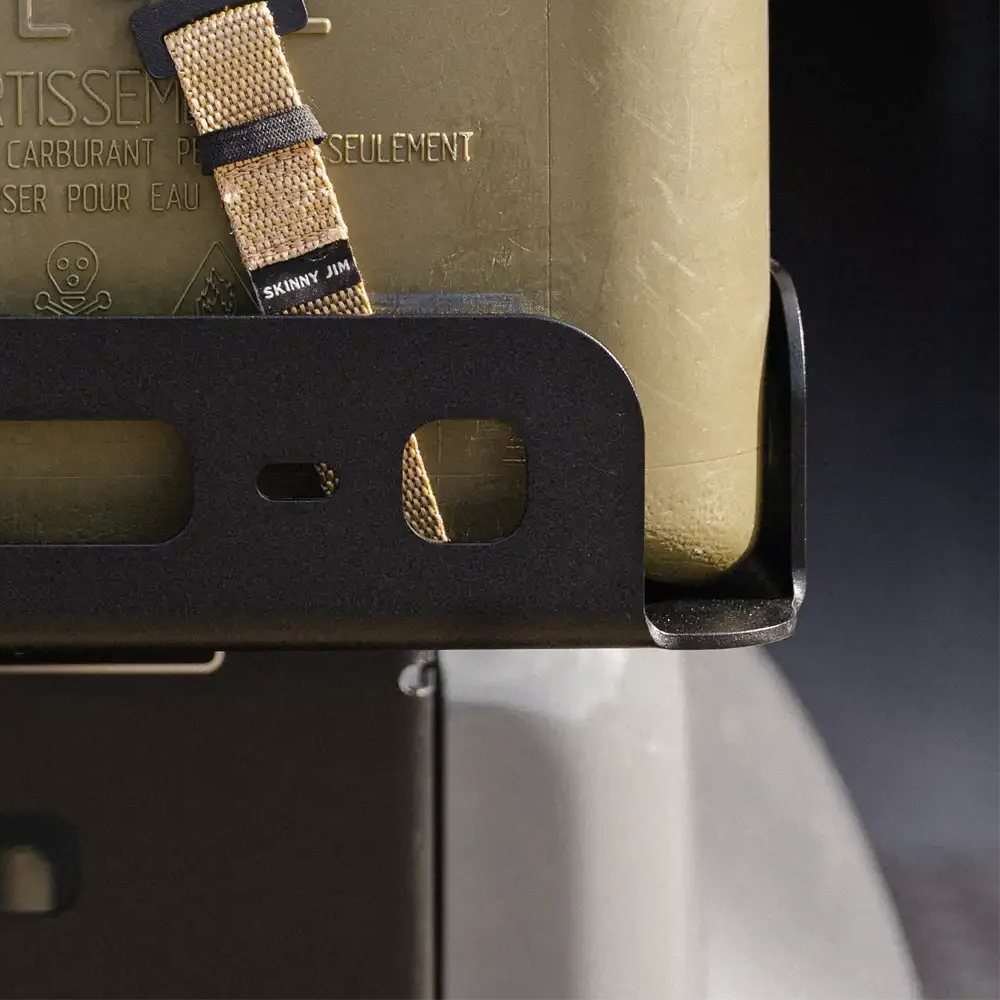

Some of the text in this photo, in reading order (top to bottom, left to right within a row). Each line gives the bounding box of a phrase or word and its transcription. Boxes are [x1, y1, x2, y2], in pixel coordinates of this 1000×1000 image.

[6, 138, 154, 169] CARBURANT
[326, 131, 475, 164] SEULEMENT
[67, 182, 131, 212] POUR
[150, 181, 200, 212] EAU
[263, 258, 351, 300] SKINNY JIM
